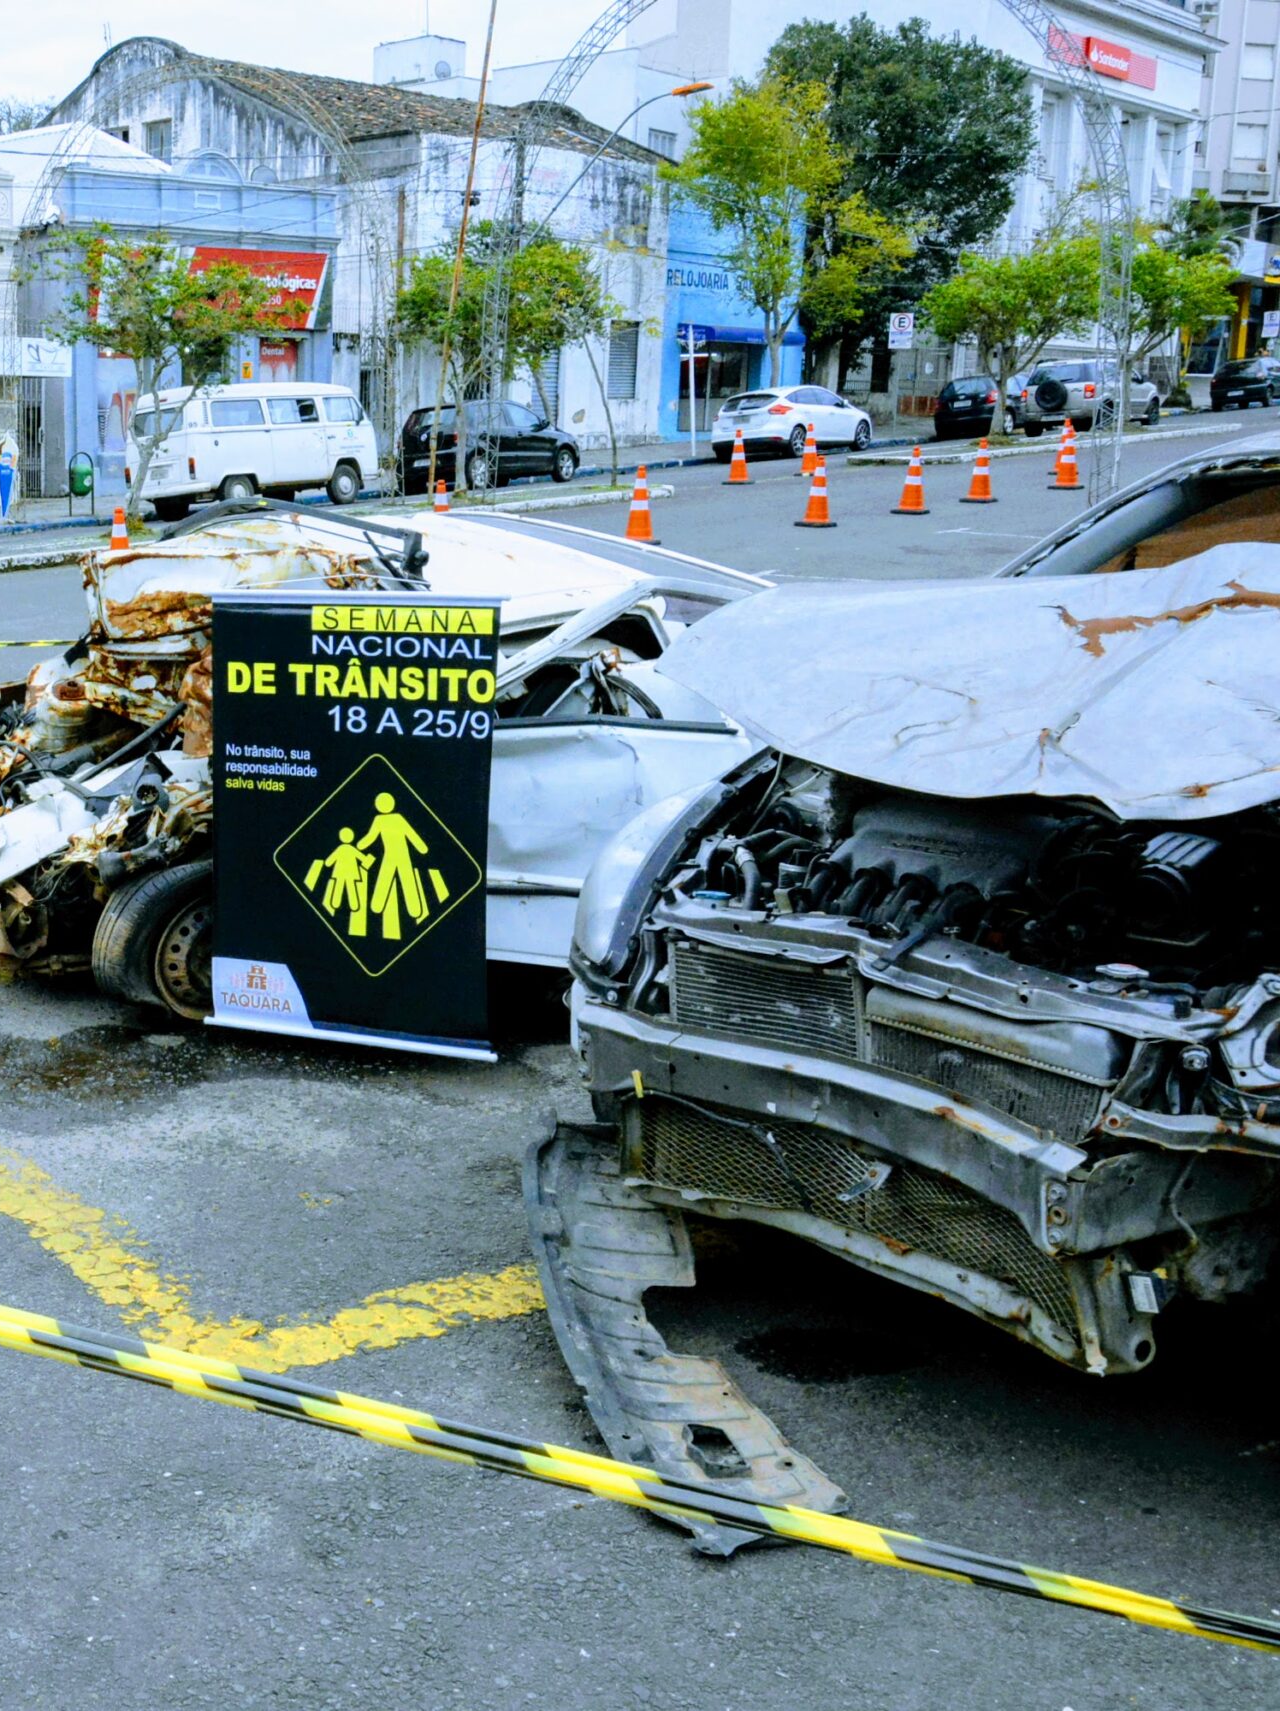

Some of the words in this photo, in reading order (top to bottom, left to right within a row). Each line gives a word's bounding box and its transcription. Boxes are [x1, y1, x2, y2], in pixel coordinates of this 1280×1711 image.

[1098, 50, 1129, 71] Santander
[666, 268, 729, 290] RELOJOARIA
[898, 316, 906, 328] E
[261, 346, 285, 355] Dental
[322, 607, 477, 633] SEMANA
[311, 634, 493, 660] NACIONAL
[226, 661, 276, 695] DE
[288, 658, 496, 703] TRÂNSITO
[327, 705, 368, 733] 18
[375, 707, 404, 735] A
[412, 708, 491, 739] 25/9
[225, 743, 242, 756] No
[244, 745, 288, 760] trânsito,
[290, 749, 311, 760] sua
[225, 762, 318, 778] responsabilidade
[225, 777, 254, 789] salva
[256, 779, 286, 792] vidas
[220, 992, 291, 1013] TAQUARA
